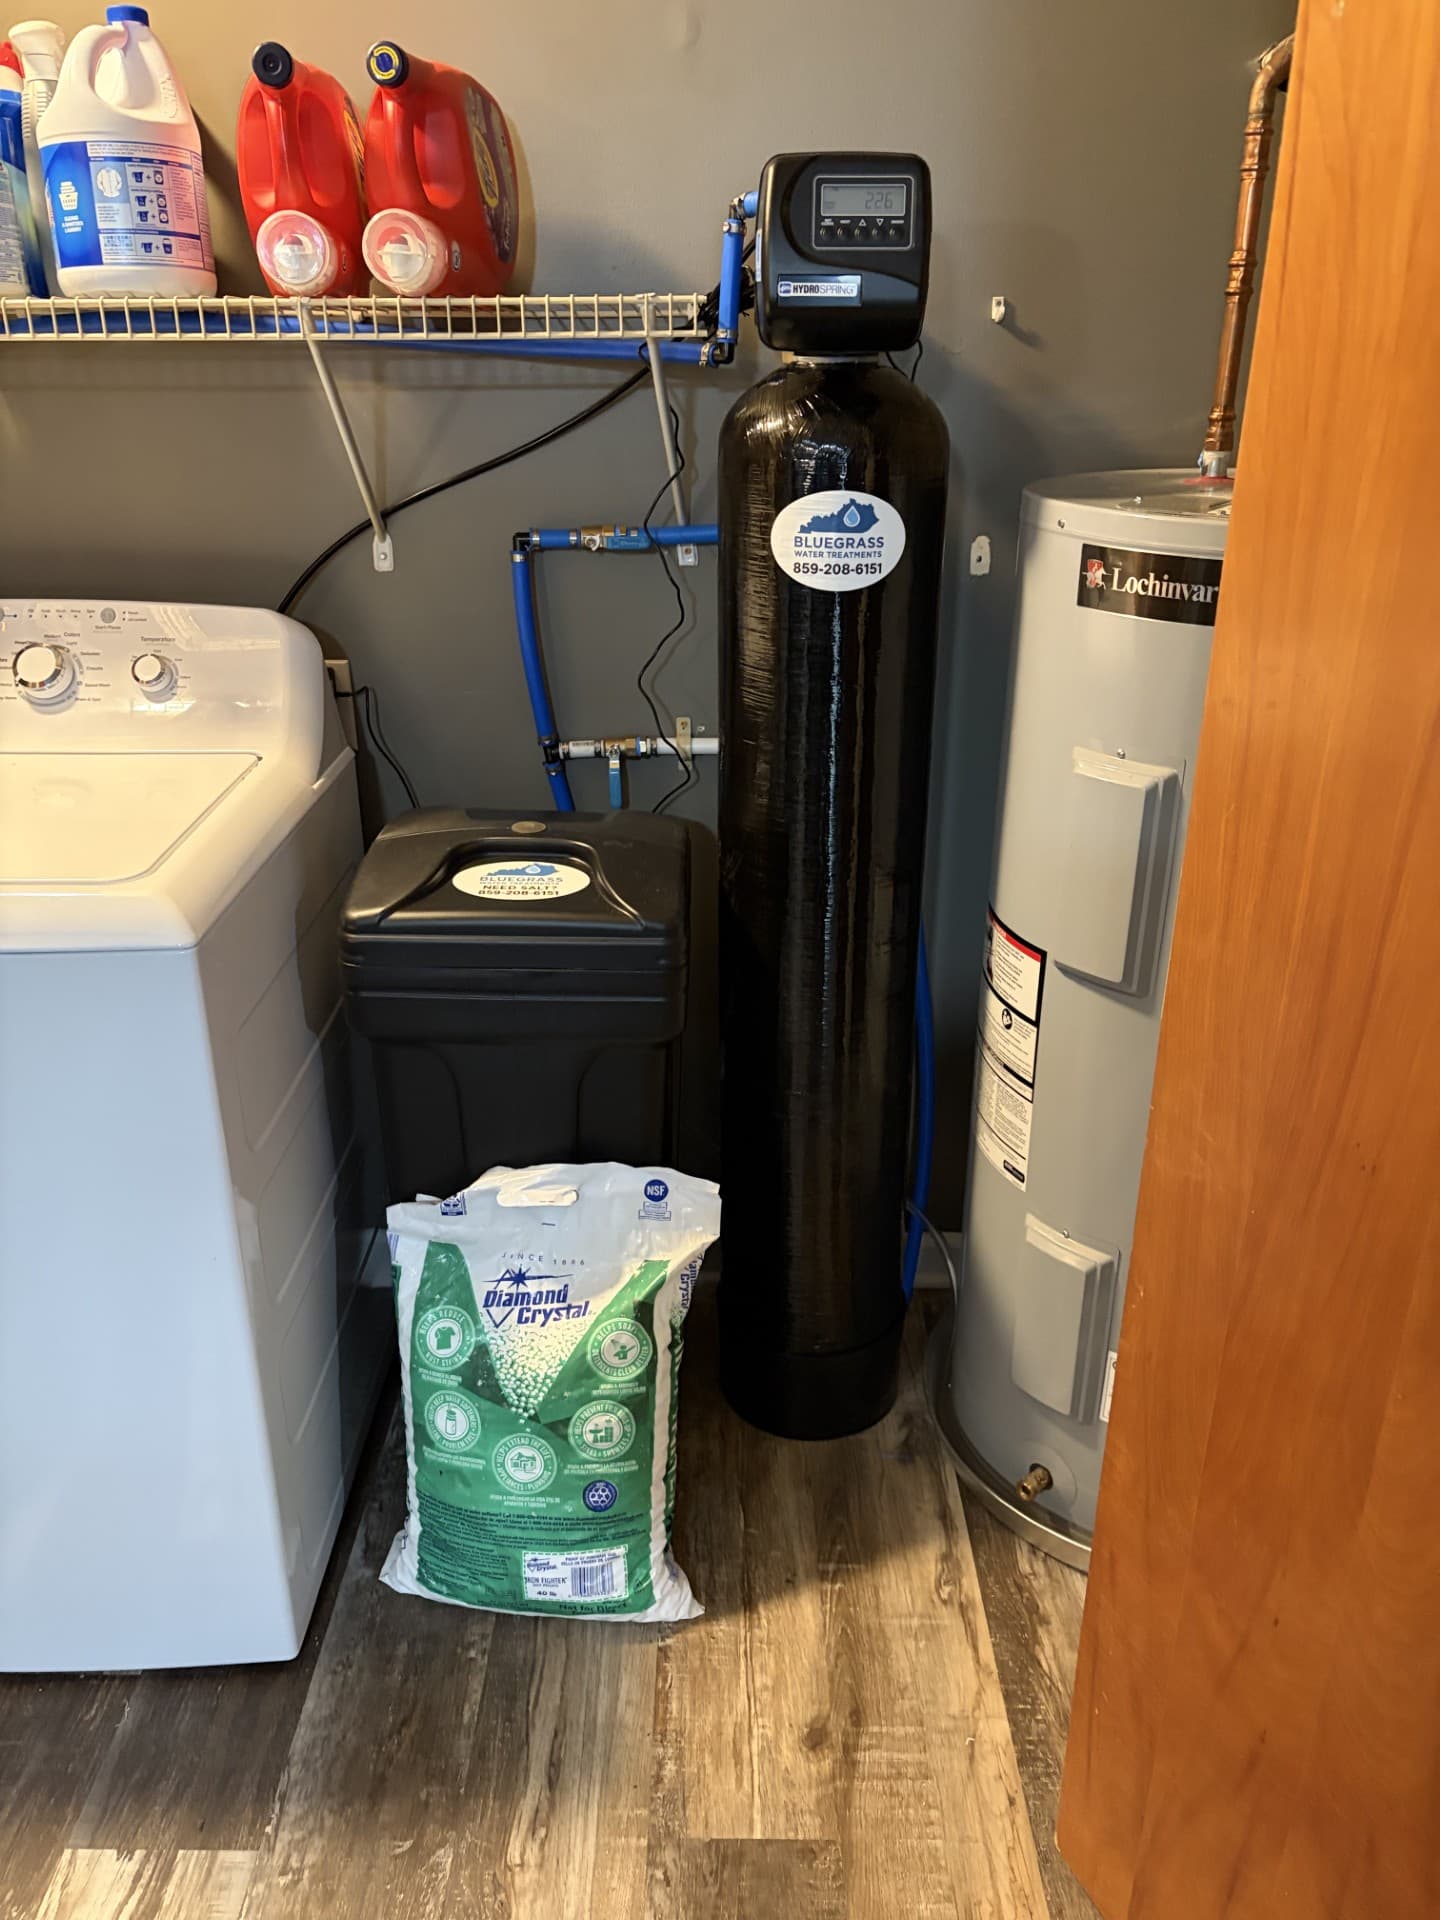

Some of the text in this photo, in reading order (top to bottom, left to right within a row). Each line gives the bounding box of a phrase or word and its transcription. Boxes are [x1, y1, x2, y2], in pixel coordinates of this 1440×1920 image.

[865, 191, 893, 209] 226
[792, 284, 854, 295] HYDROSPRING
[794, 536, 885, 549] BLUEGRASS
[794, 550, 882, 559] WATER TREATMENTS
[793, 562, 882, 575] 859-208-6151
[1112, 567, 1219, 603] Lochinvar
[647, 1185, 665, 1196] NSF
[483, 1284, 569, 1308] Diamond
[517, 1301, 590, 1327] Crystal
[596, 1323, 617, 1341] HELPS
[617, 1364, 637, 1377] CLEAN
